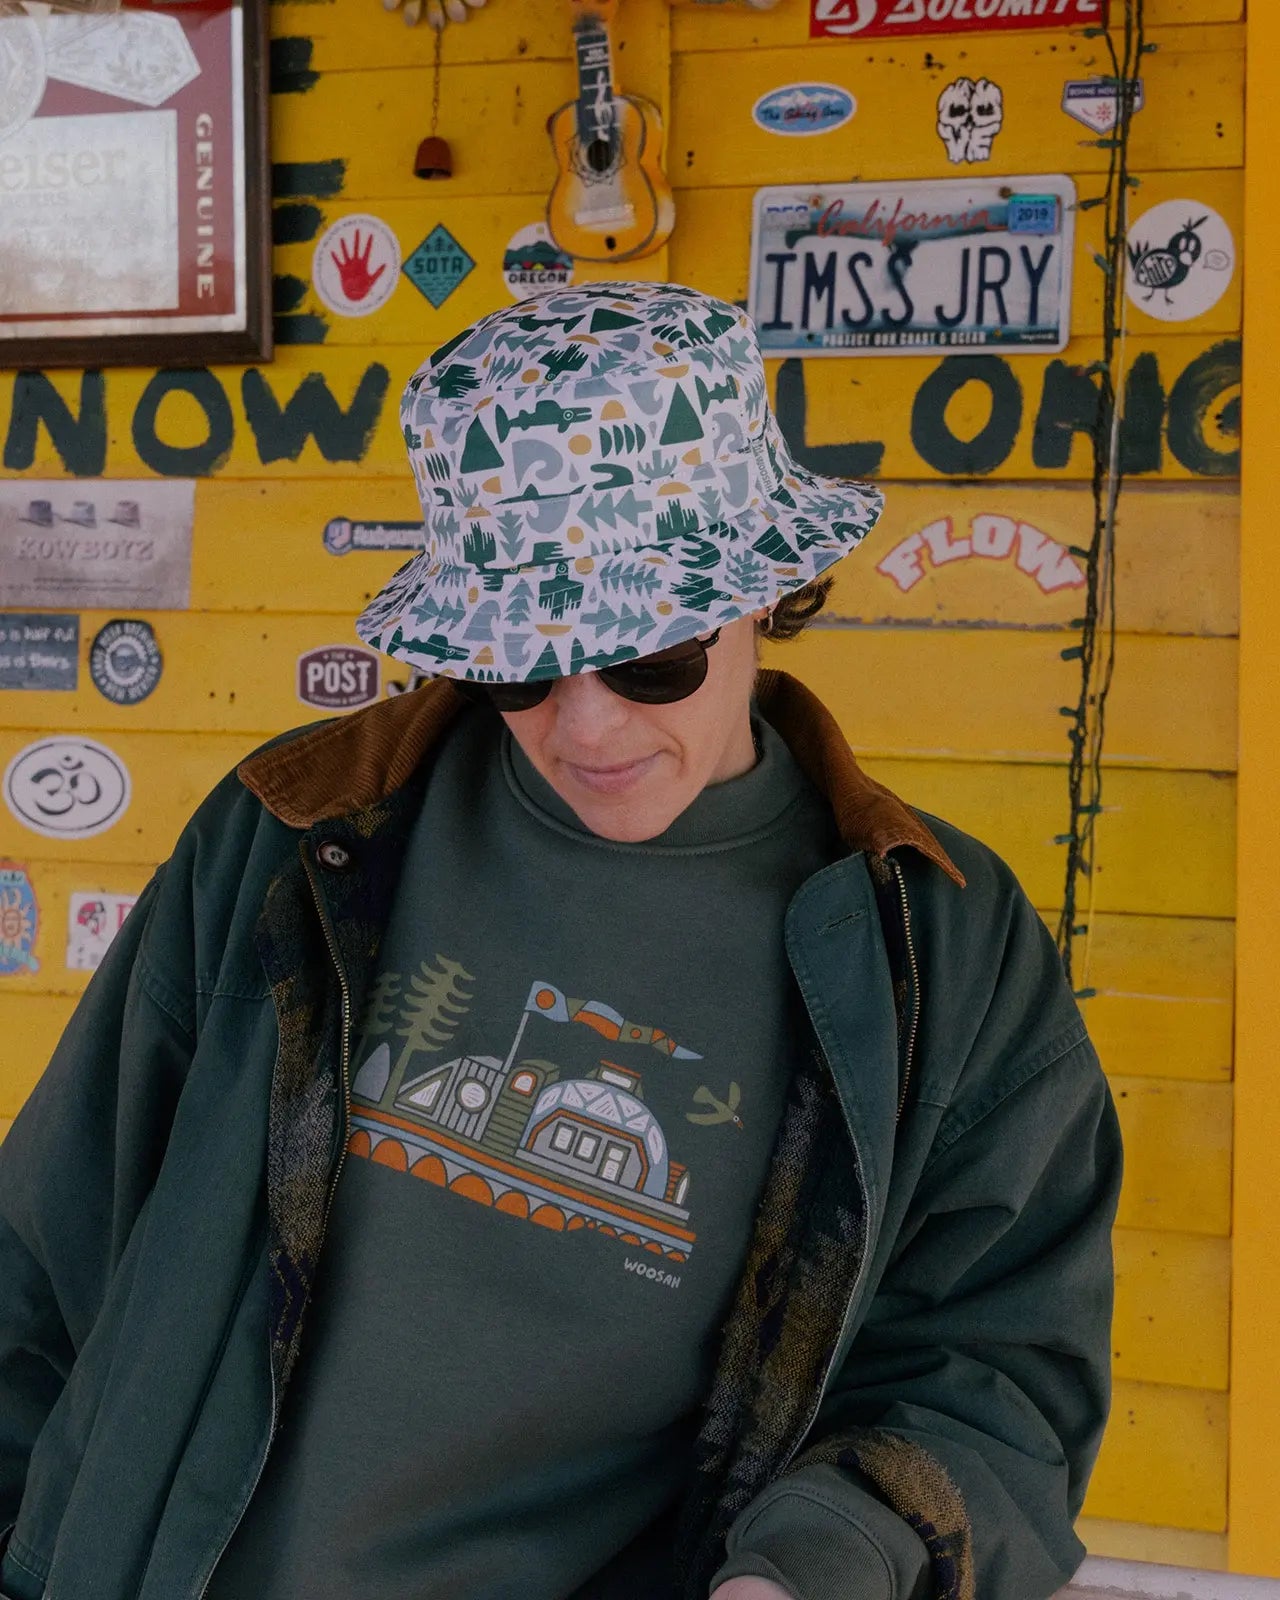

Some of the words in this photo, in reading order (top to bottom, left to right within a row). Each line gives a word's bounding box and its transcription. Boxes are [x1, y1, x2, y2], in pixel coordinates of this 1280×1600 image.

[195, 112, 216, 300] GENUINE
[814, 197, 1009, 247] California
[1017, 207, 1050, 222] 2019
[414, 255, 464, 275] SOTA
[508, 272, 569, 284] OREGON
[761, 249, 914, 331] IMSS
[935, 243, 1056, 329] JRY
[822, 332, 870, 347] PROTECT
[874, 332, 897, 346] OUR
[900, 331, 935, 346] COAST
[3, 362, 391, 477] NOW
[876, 512, 1087, 595] FLOW
[306, 661, 372, 694] POST
[624, 1257, 681, 1289] WOOSAH
